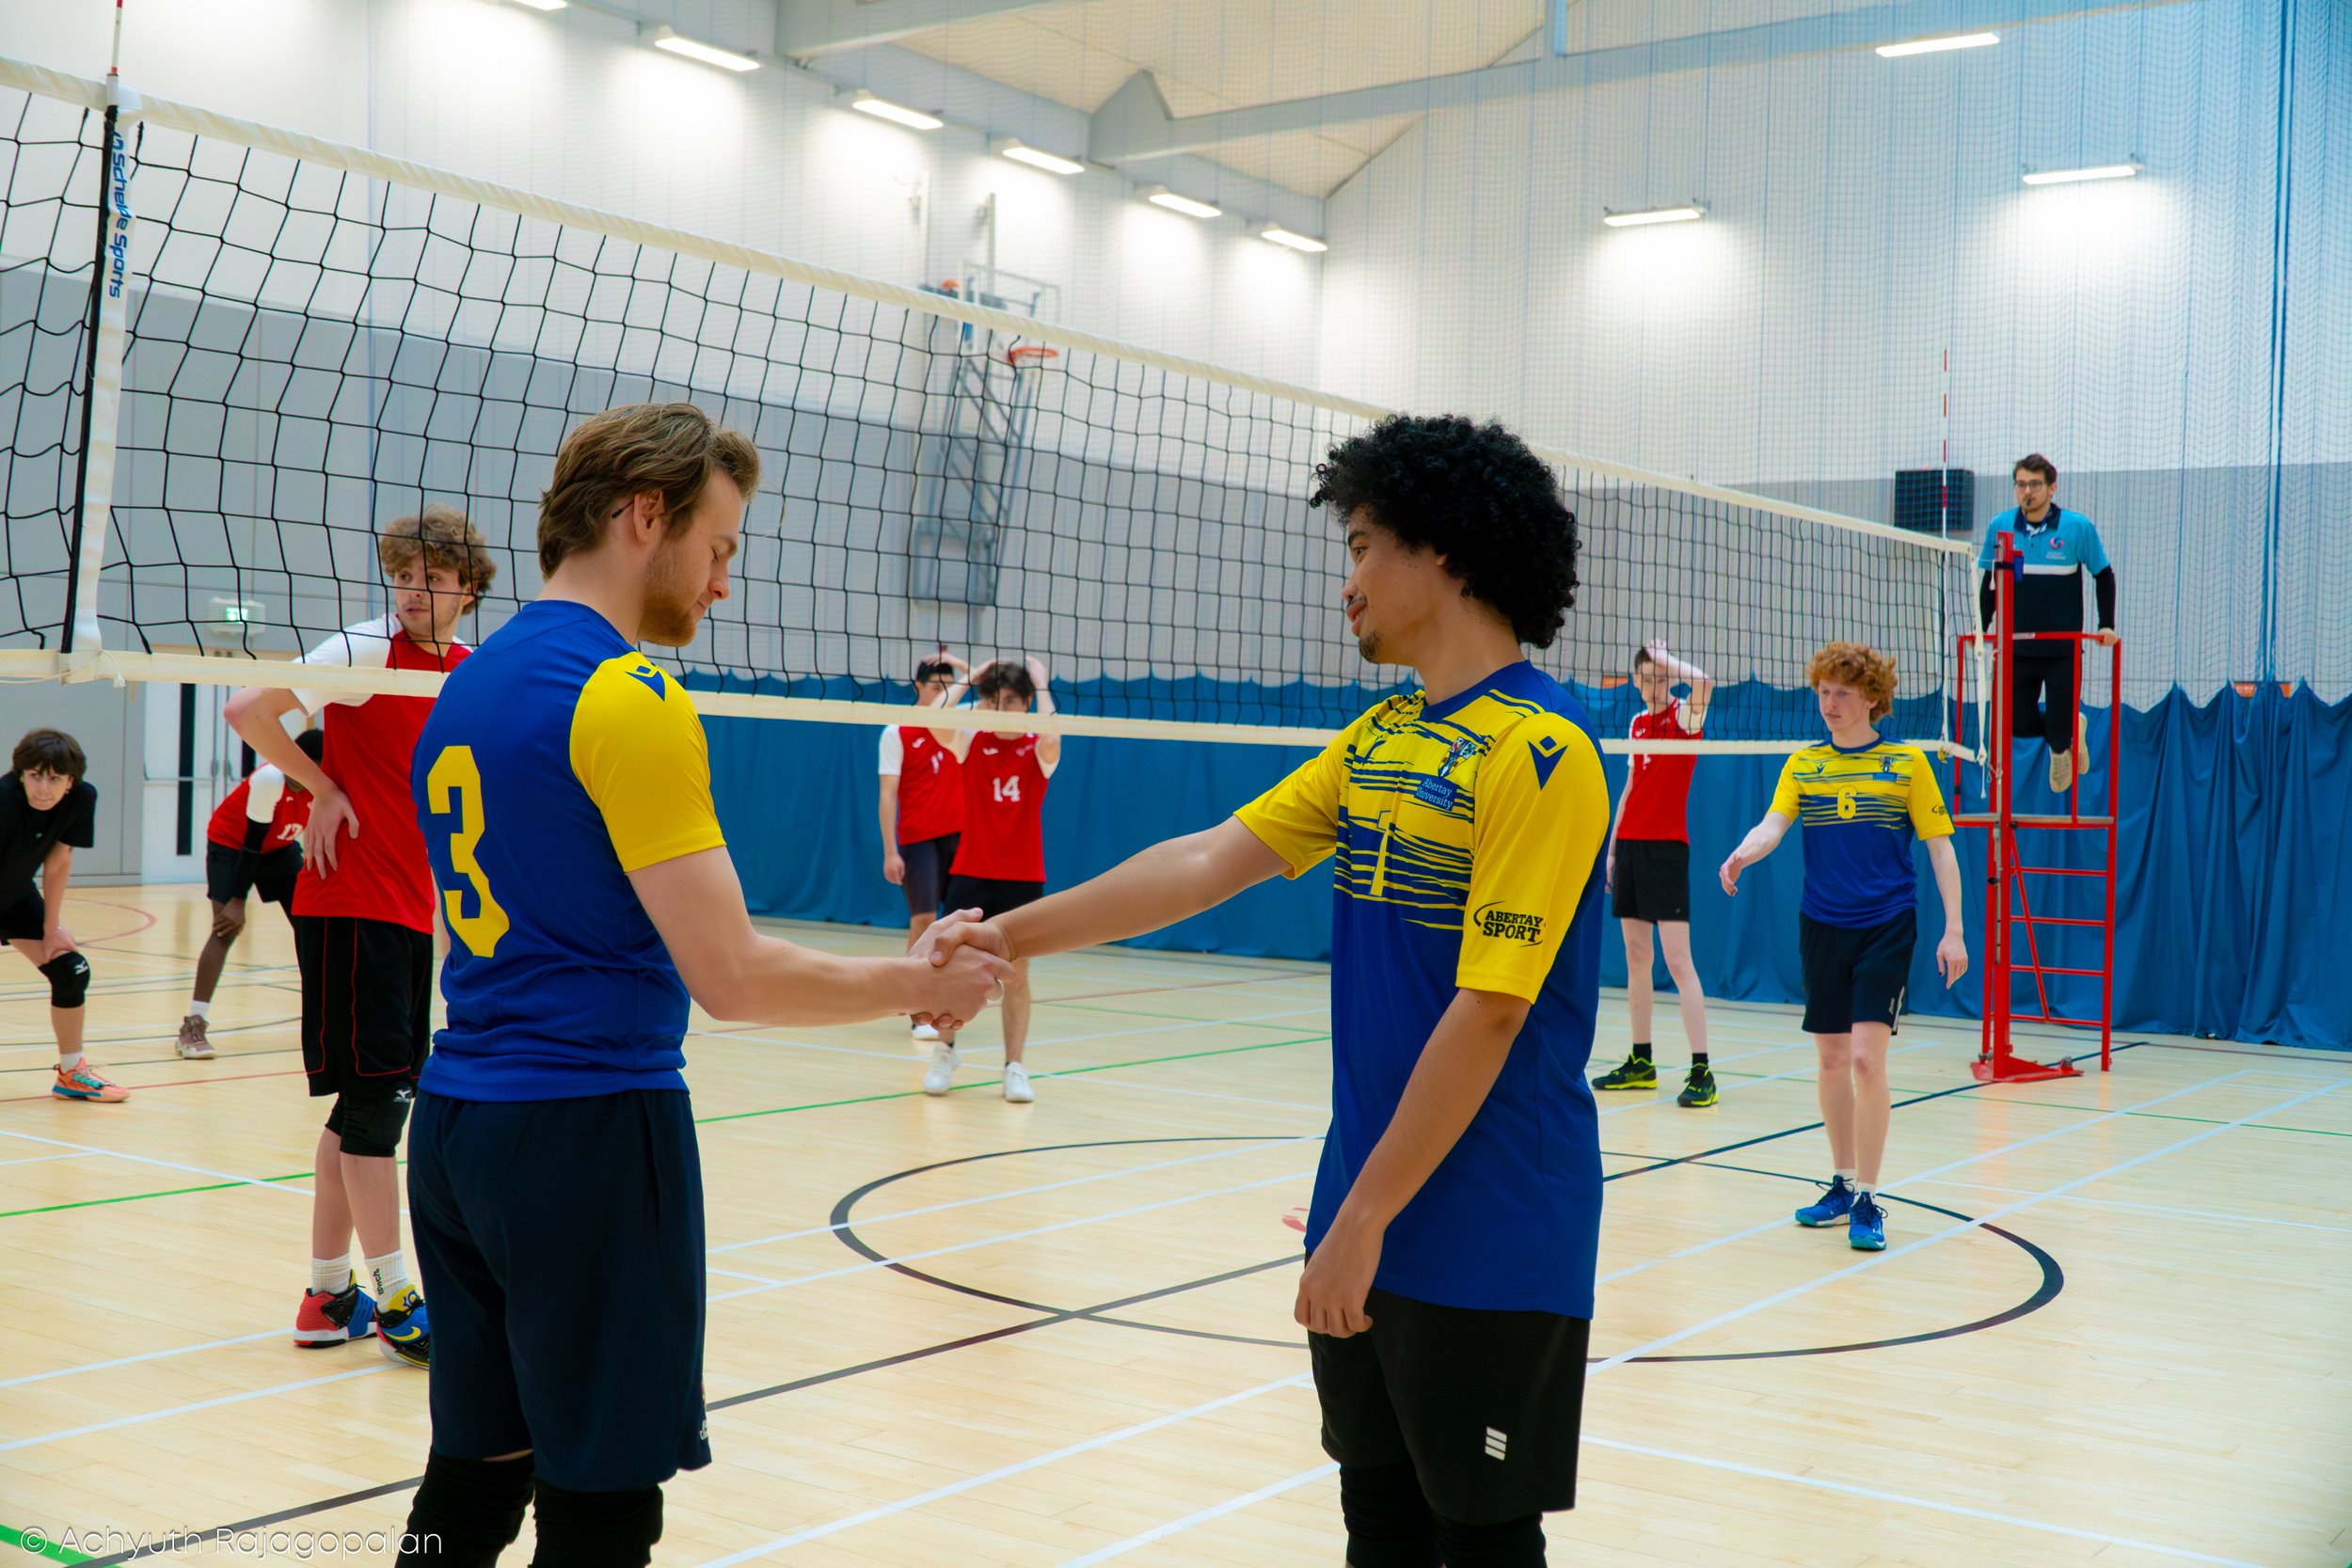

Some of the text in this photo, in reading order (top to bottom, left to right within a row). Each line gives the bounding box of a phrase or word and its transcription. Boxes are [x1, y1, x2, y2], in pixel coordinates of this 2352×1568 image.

[109, 151, 133, 298] Schelde Sports
[992, 774, 1021, 803] 14
[1415, 786, 1454, 810] University
[1422, 778, 1453, 798] Abertay
[1837, 785, 1858, 820] 6
[427, 745, 511, 958] 3
[1482, 921, 1542, 943] SPORT
[1485, 910, 1544, 928] ABERTAY
